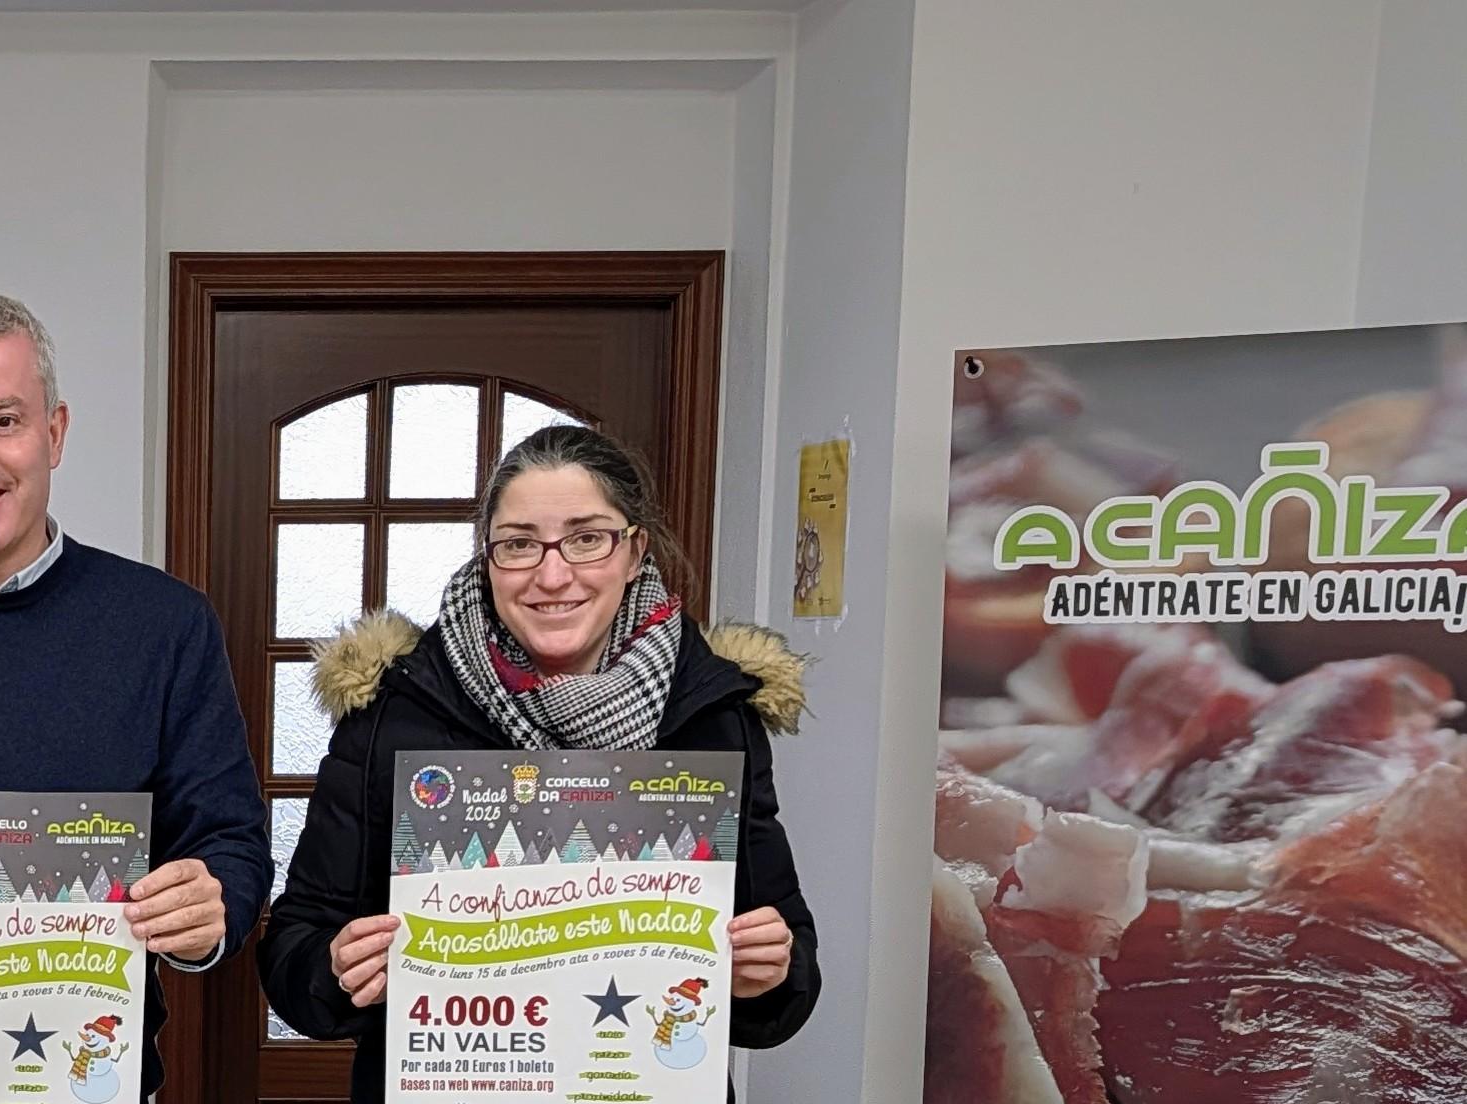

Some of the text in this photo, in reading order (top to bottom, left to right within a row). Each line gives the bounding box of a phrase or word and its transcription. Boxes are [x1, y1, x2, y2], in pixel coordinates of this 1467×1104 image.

[1050, 576, 1467, 626] ADÉNTRATE EN GALICIA!
[462, 788, 508, 804] Nadal
[421, 867, 701, 922] A confianza de sempre
[7, 908, 35, 937] de
[41, 911, 117, 943] sempre
[565, 915, 612, 940] este
[619, 909, 703, 936] Nadal
[37, 946, 117, 973] Nadal
[408, 994, 549, 1027] 4.000 €
[408, 1031, 546, 1053] EN VALES
[401, 1059, 422, 1073] Por
[424, 1059, 452, 1073] cada
[455, 1060, 469, 1073] 20
[472, 1060, 506, 1073] Euros
[517, 1060, 554, 1074] boleto
[400, 1078, 554, 1093] Bases na web www.caniza.org
